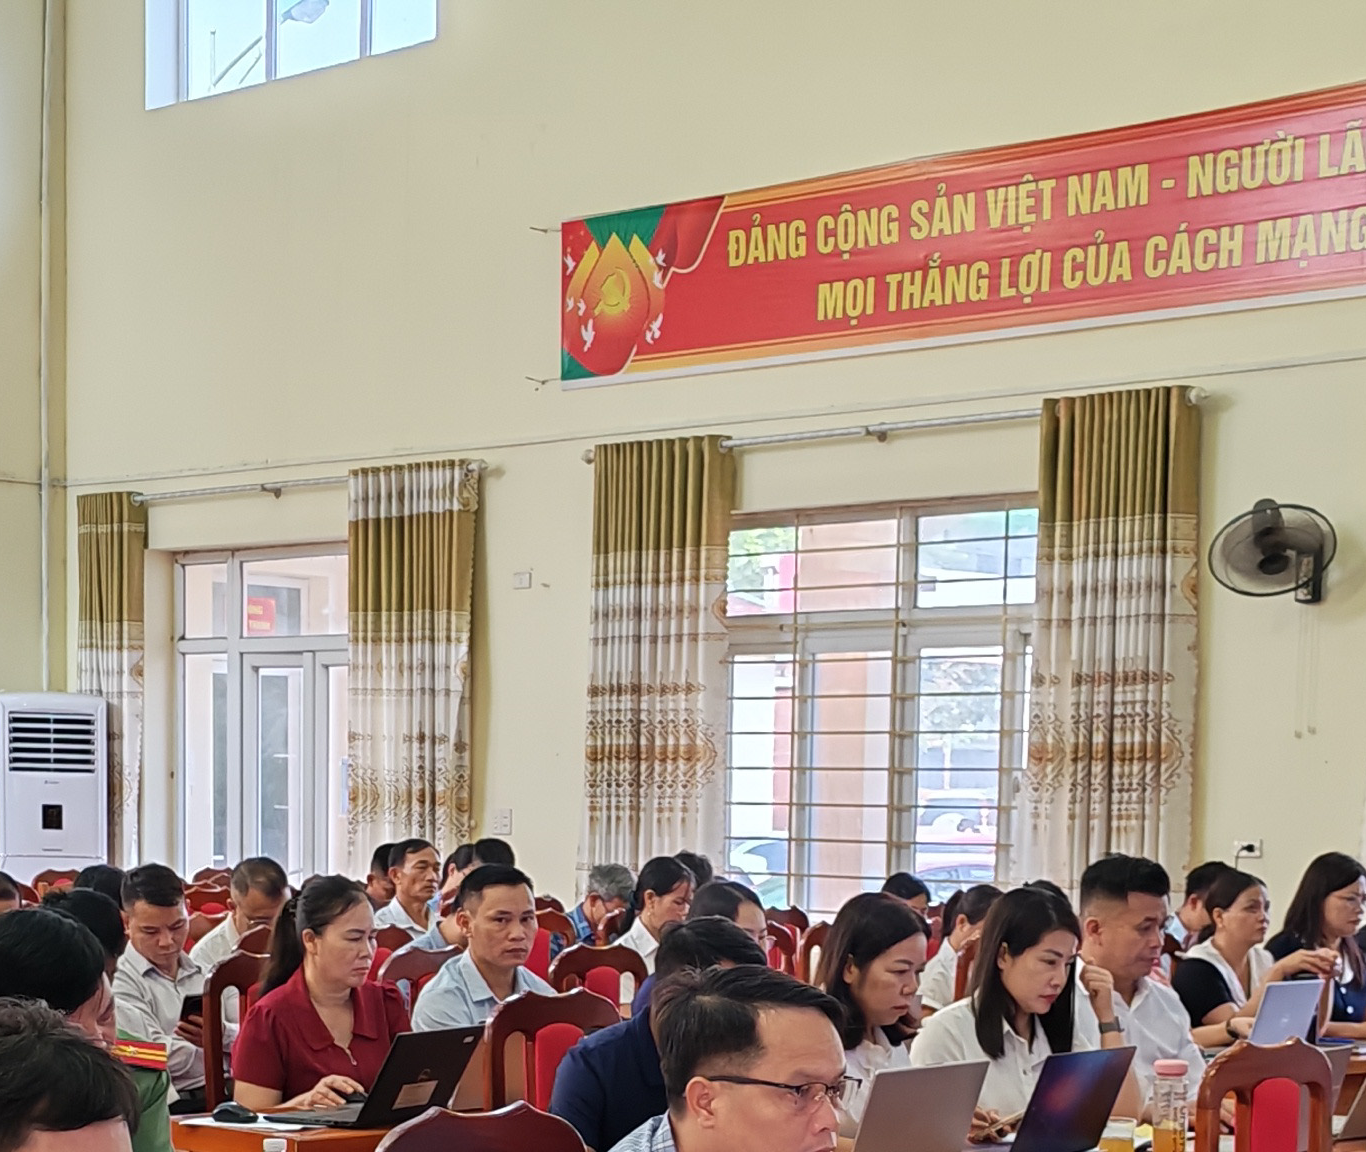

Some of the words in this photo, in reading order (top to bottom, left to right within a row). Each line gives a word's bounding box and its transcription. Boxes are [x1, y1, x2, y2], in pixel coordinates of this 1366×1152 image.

[727, 213, 807, 267] ĐẢNG
[816, 203, 899, 263] CỘNG
[910, 183, 977, 241] SẢN
[986, 174, 1057, 234] VIỆT
[1067, 163, 1149, 217] NAM
[1187, 130, 1305, 199] NGƯỜI
[817, 276, 874, 326] MỌI
[886, 251, 989, 312] THẮNG
[999, 249, 1052, 304] LỢI
[1062, 230, 1132, 291] CỦA
[1144, 223, 1243, 279] CÁCH
